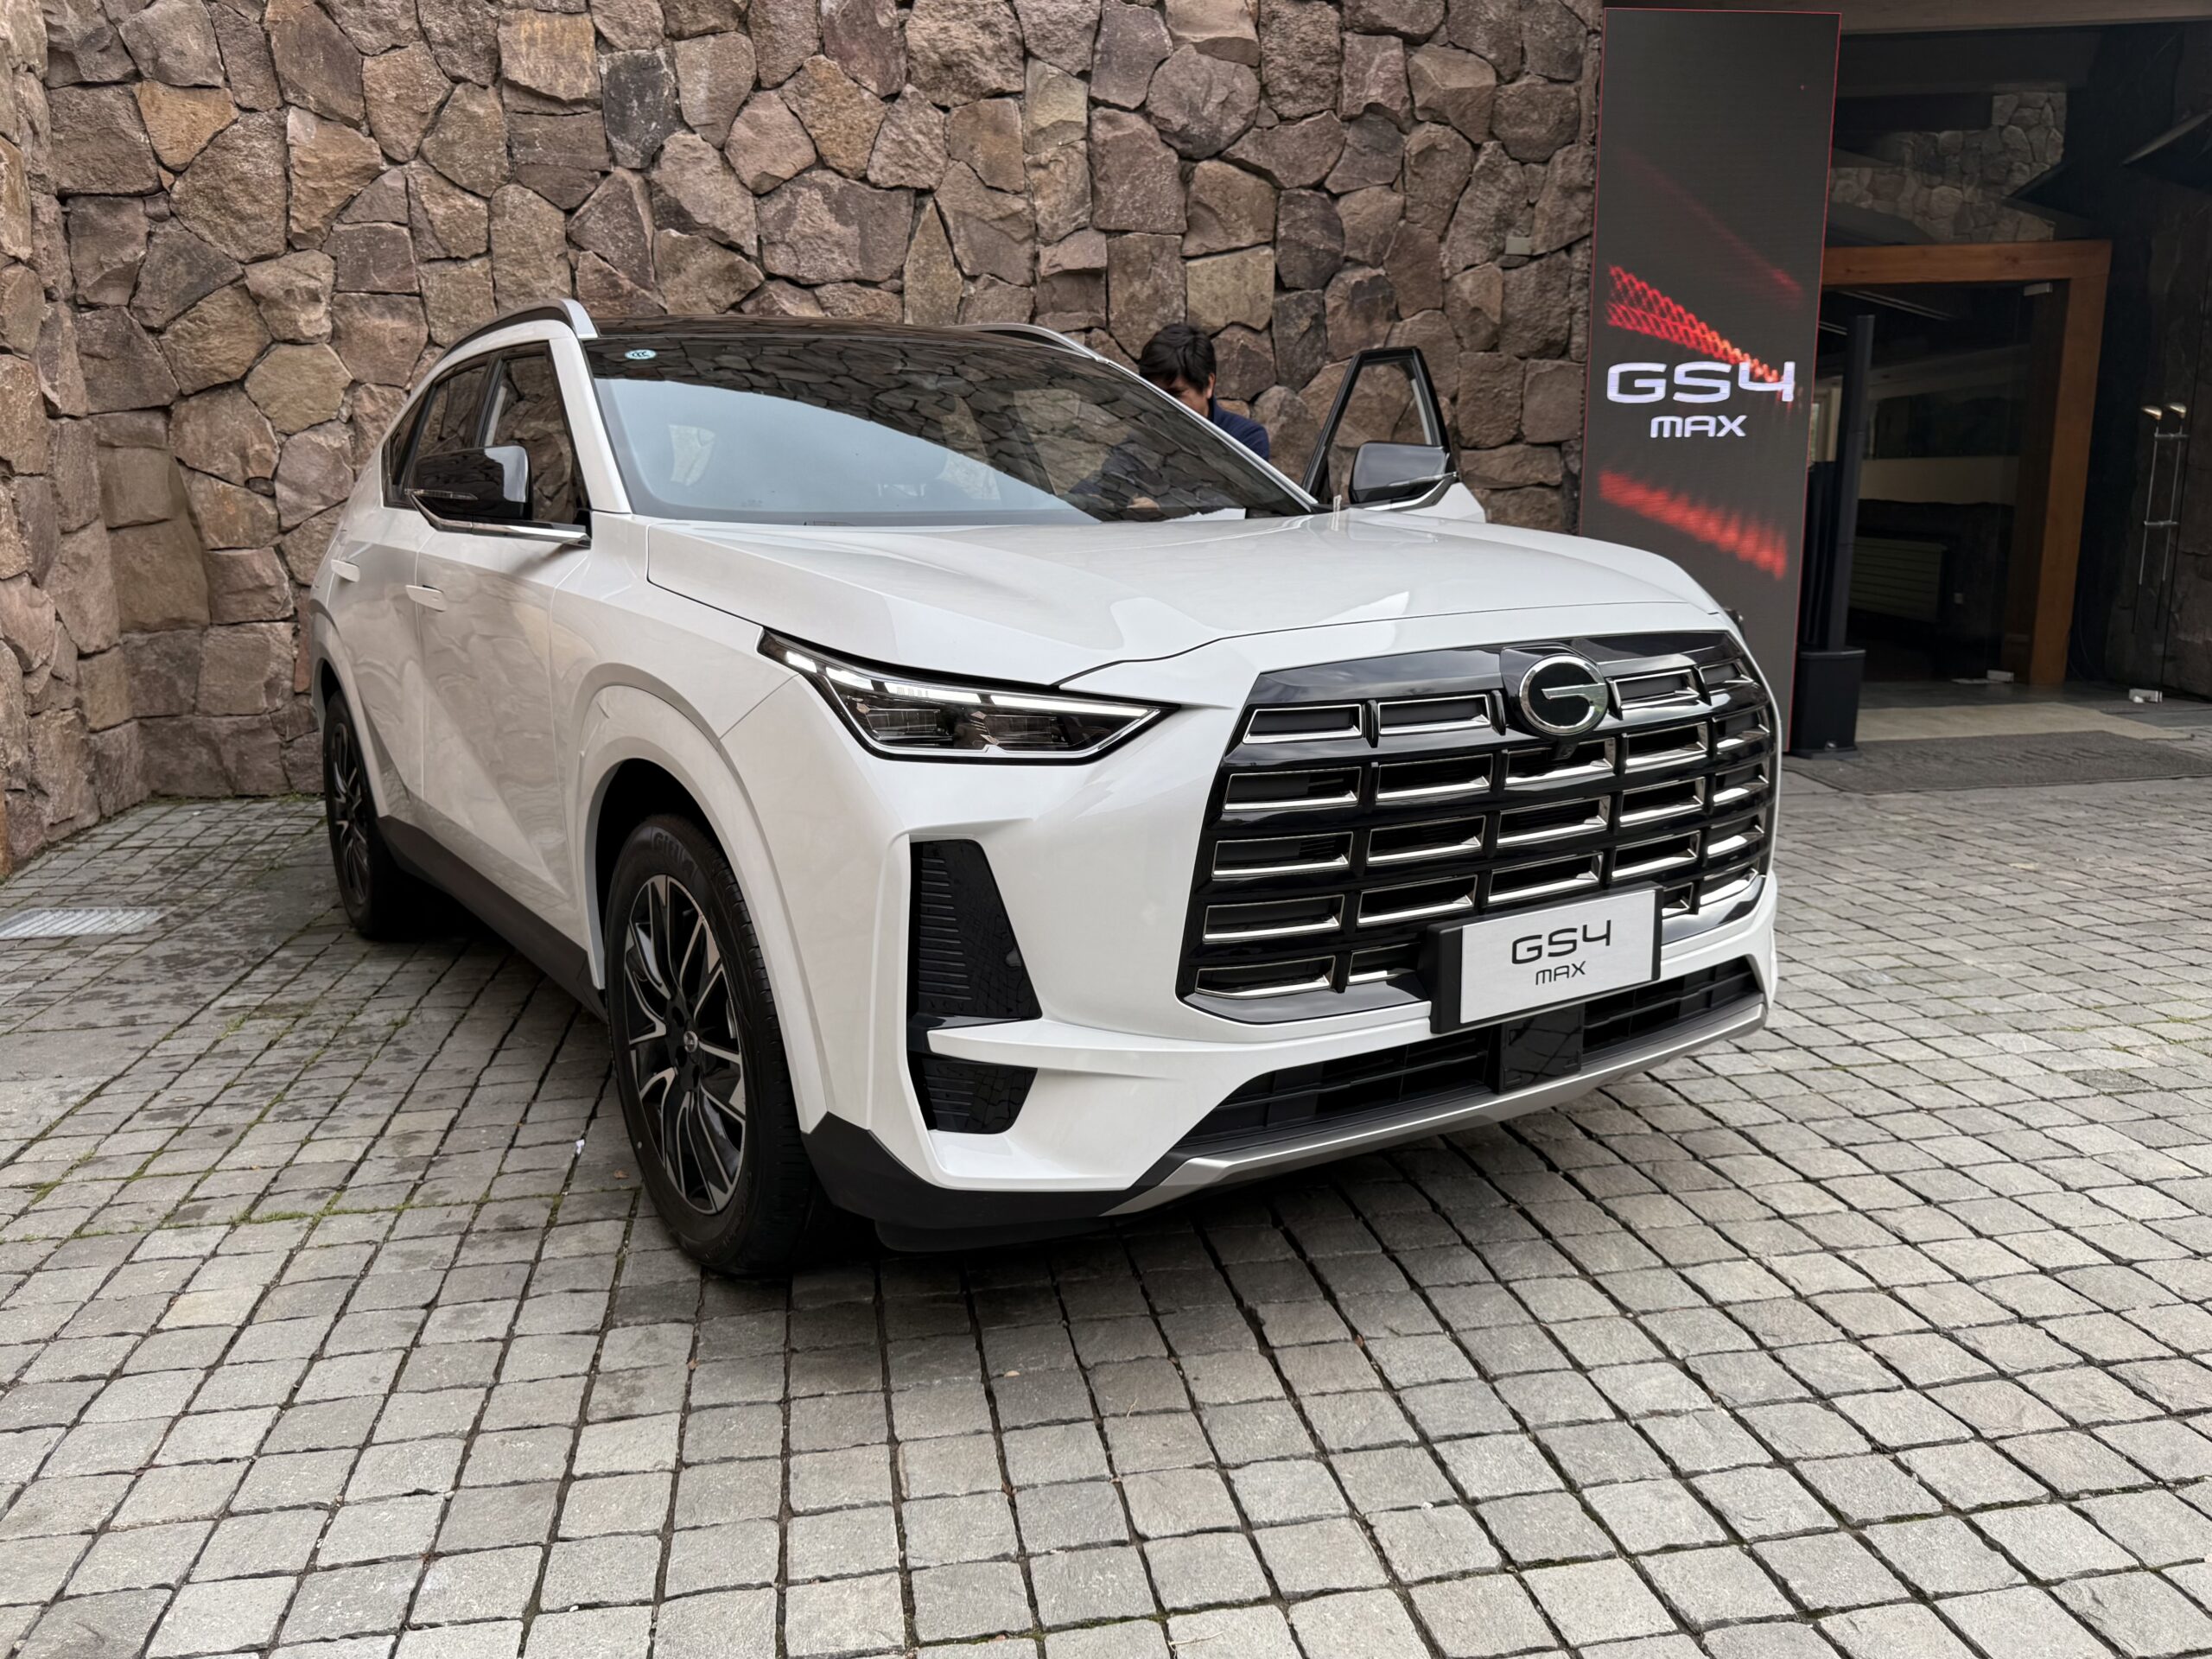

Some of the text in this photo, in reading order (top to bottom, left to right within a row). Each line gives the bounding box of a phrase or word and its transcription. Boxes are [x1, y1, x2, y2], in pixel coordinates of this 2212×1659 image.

[1607, 361, 1796, 404] GS4
[1650, 415, 1747, 438] MAX
[1512, 919, 1611, 964] GS4
[1535, 961, 1586, 985] MAX
